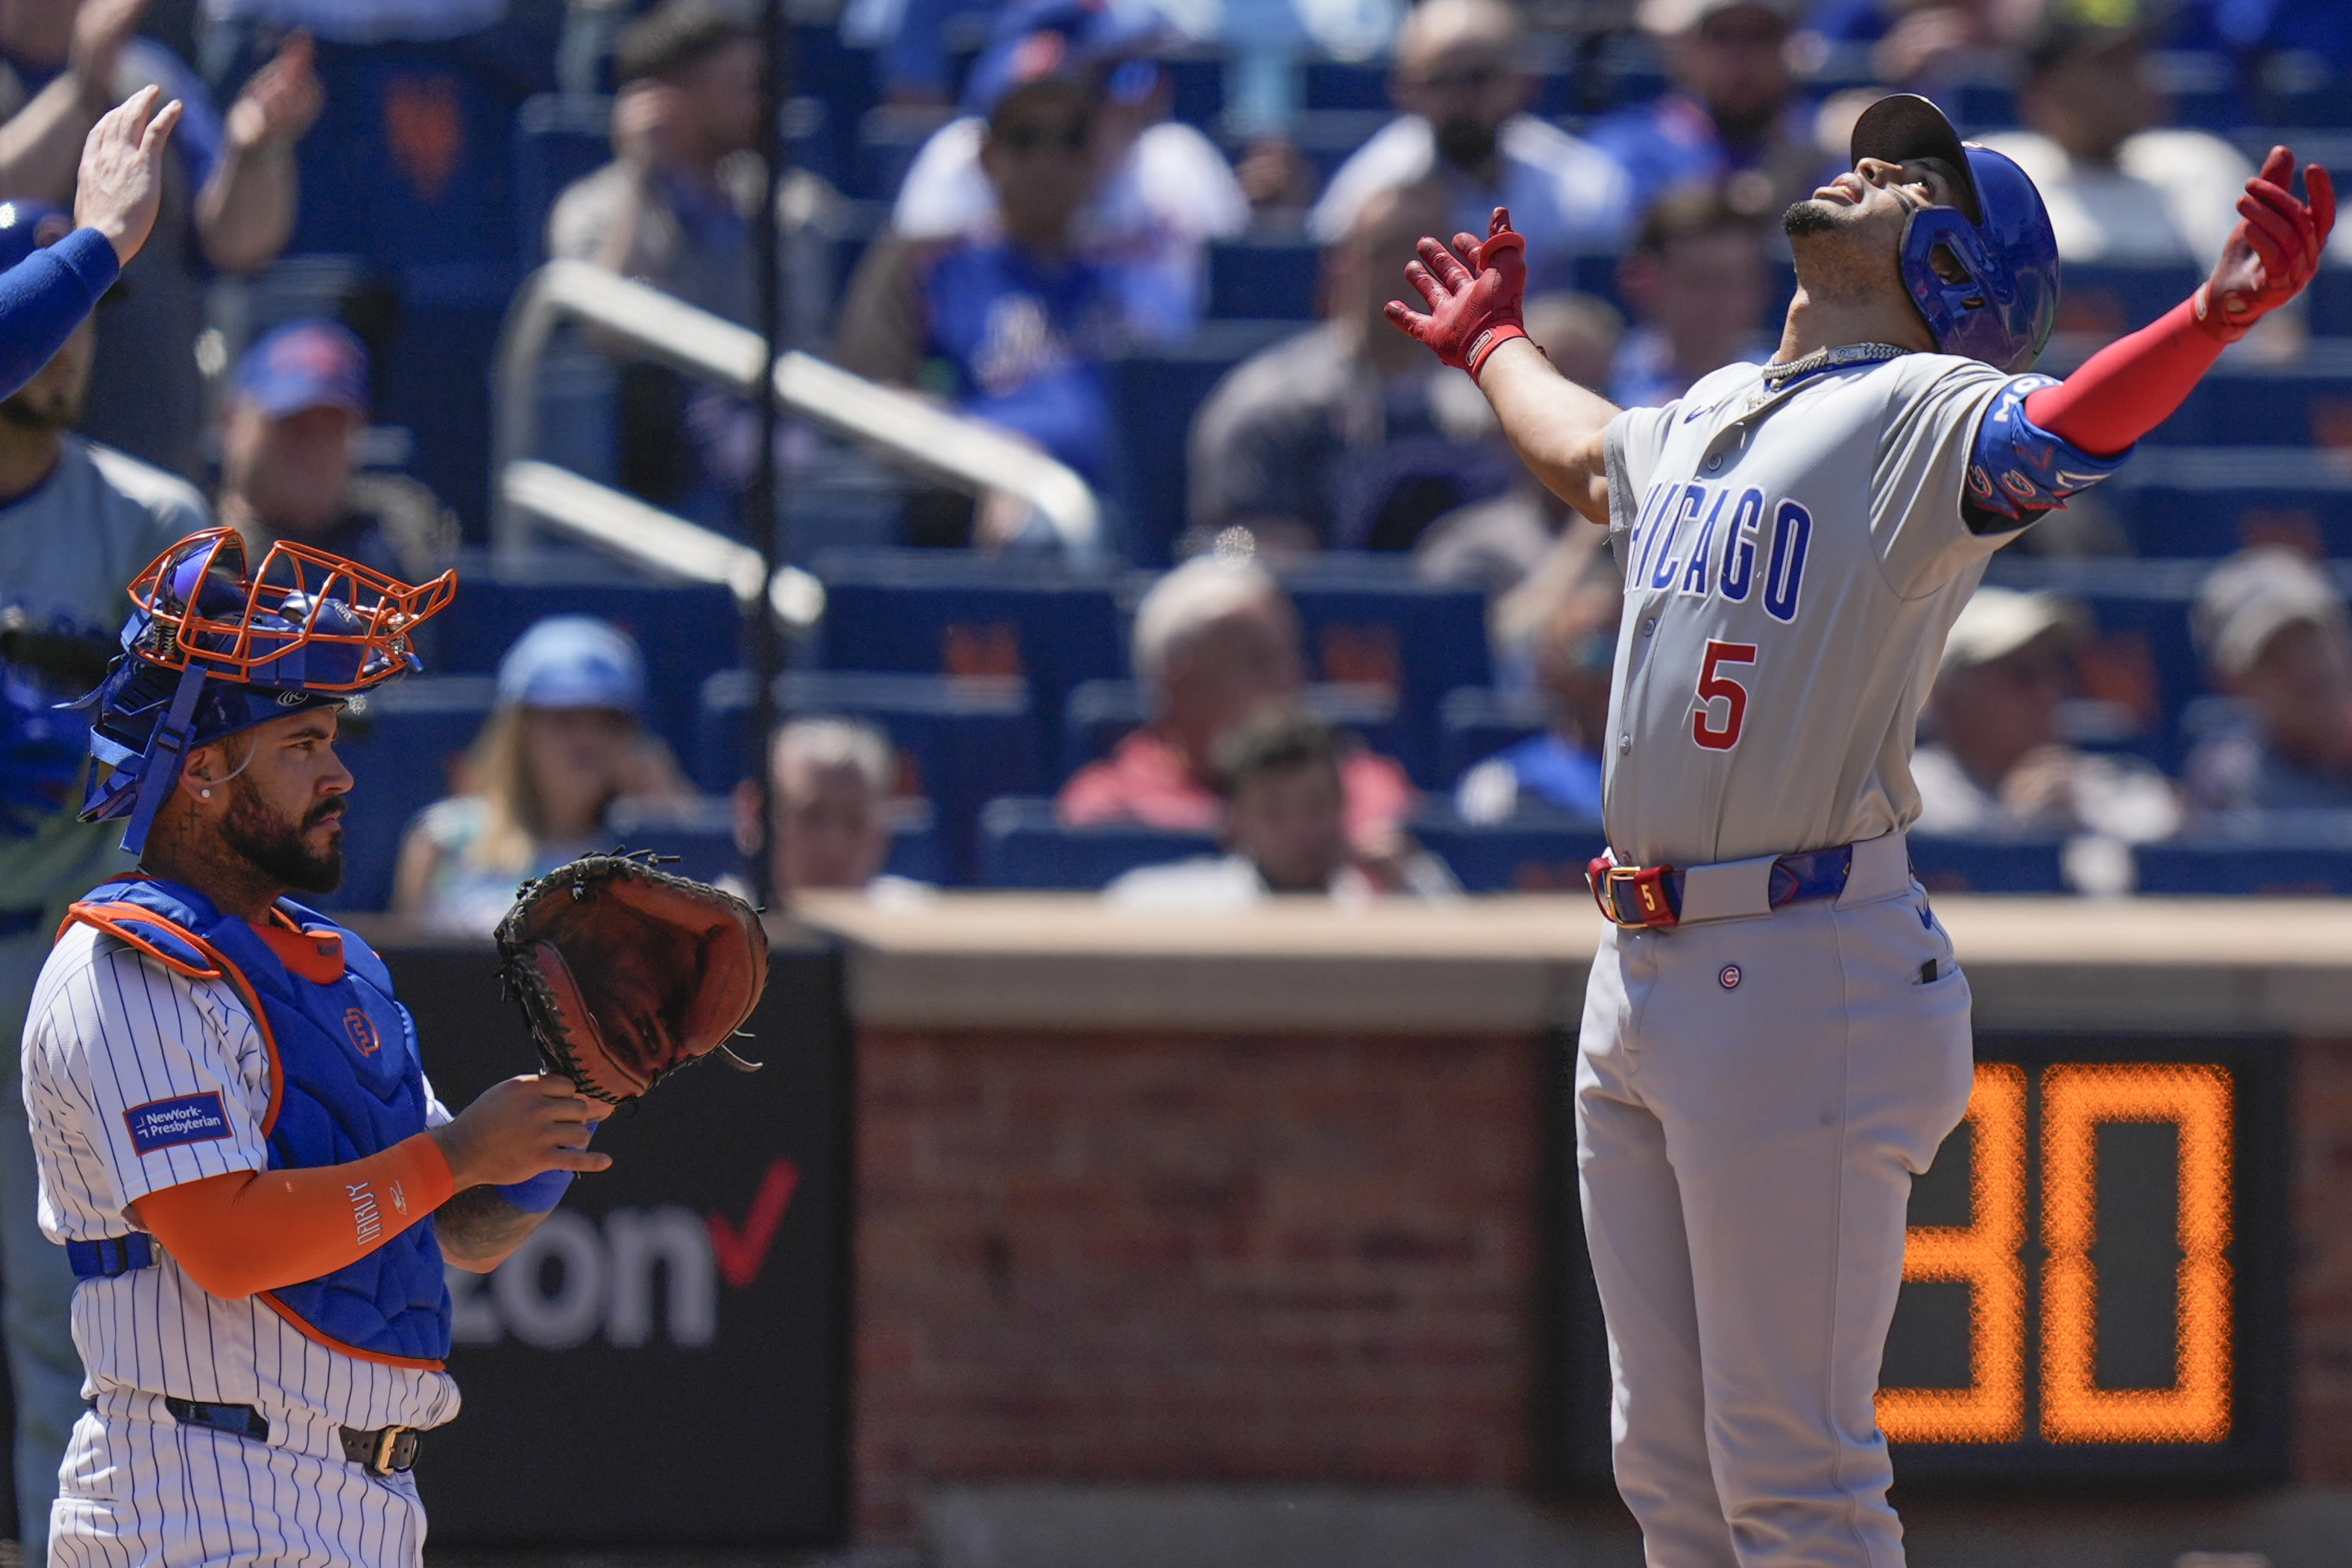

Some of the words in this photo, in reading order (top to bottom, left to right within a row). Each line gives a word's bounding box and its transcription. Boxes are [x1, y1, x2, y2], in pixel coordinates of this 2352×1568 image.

[1623, 479, 1814, 625] HICAGO
[1692, 637, 1758, 752] 5
[1641, 884, 1655, 912] 5
[146, 1106, 203, 1125] NewYork-
[150, 1115, 221, 1136] Presbyterian
[1875, 1062, 2235, 1443] 30
